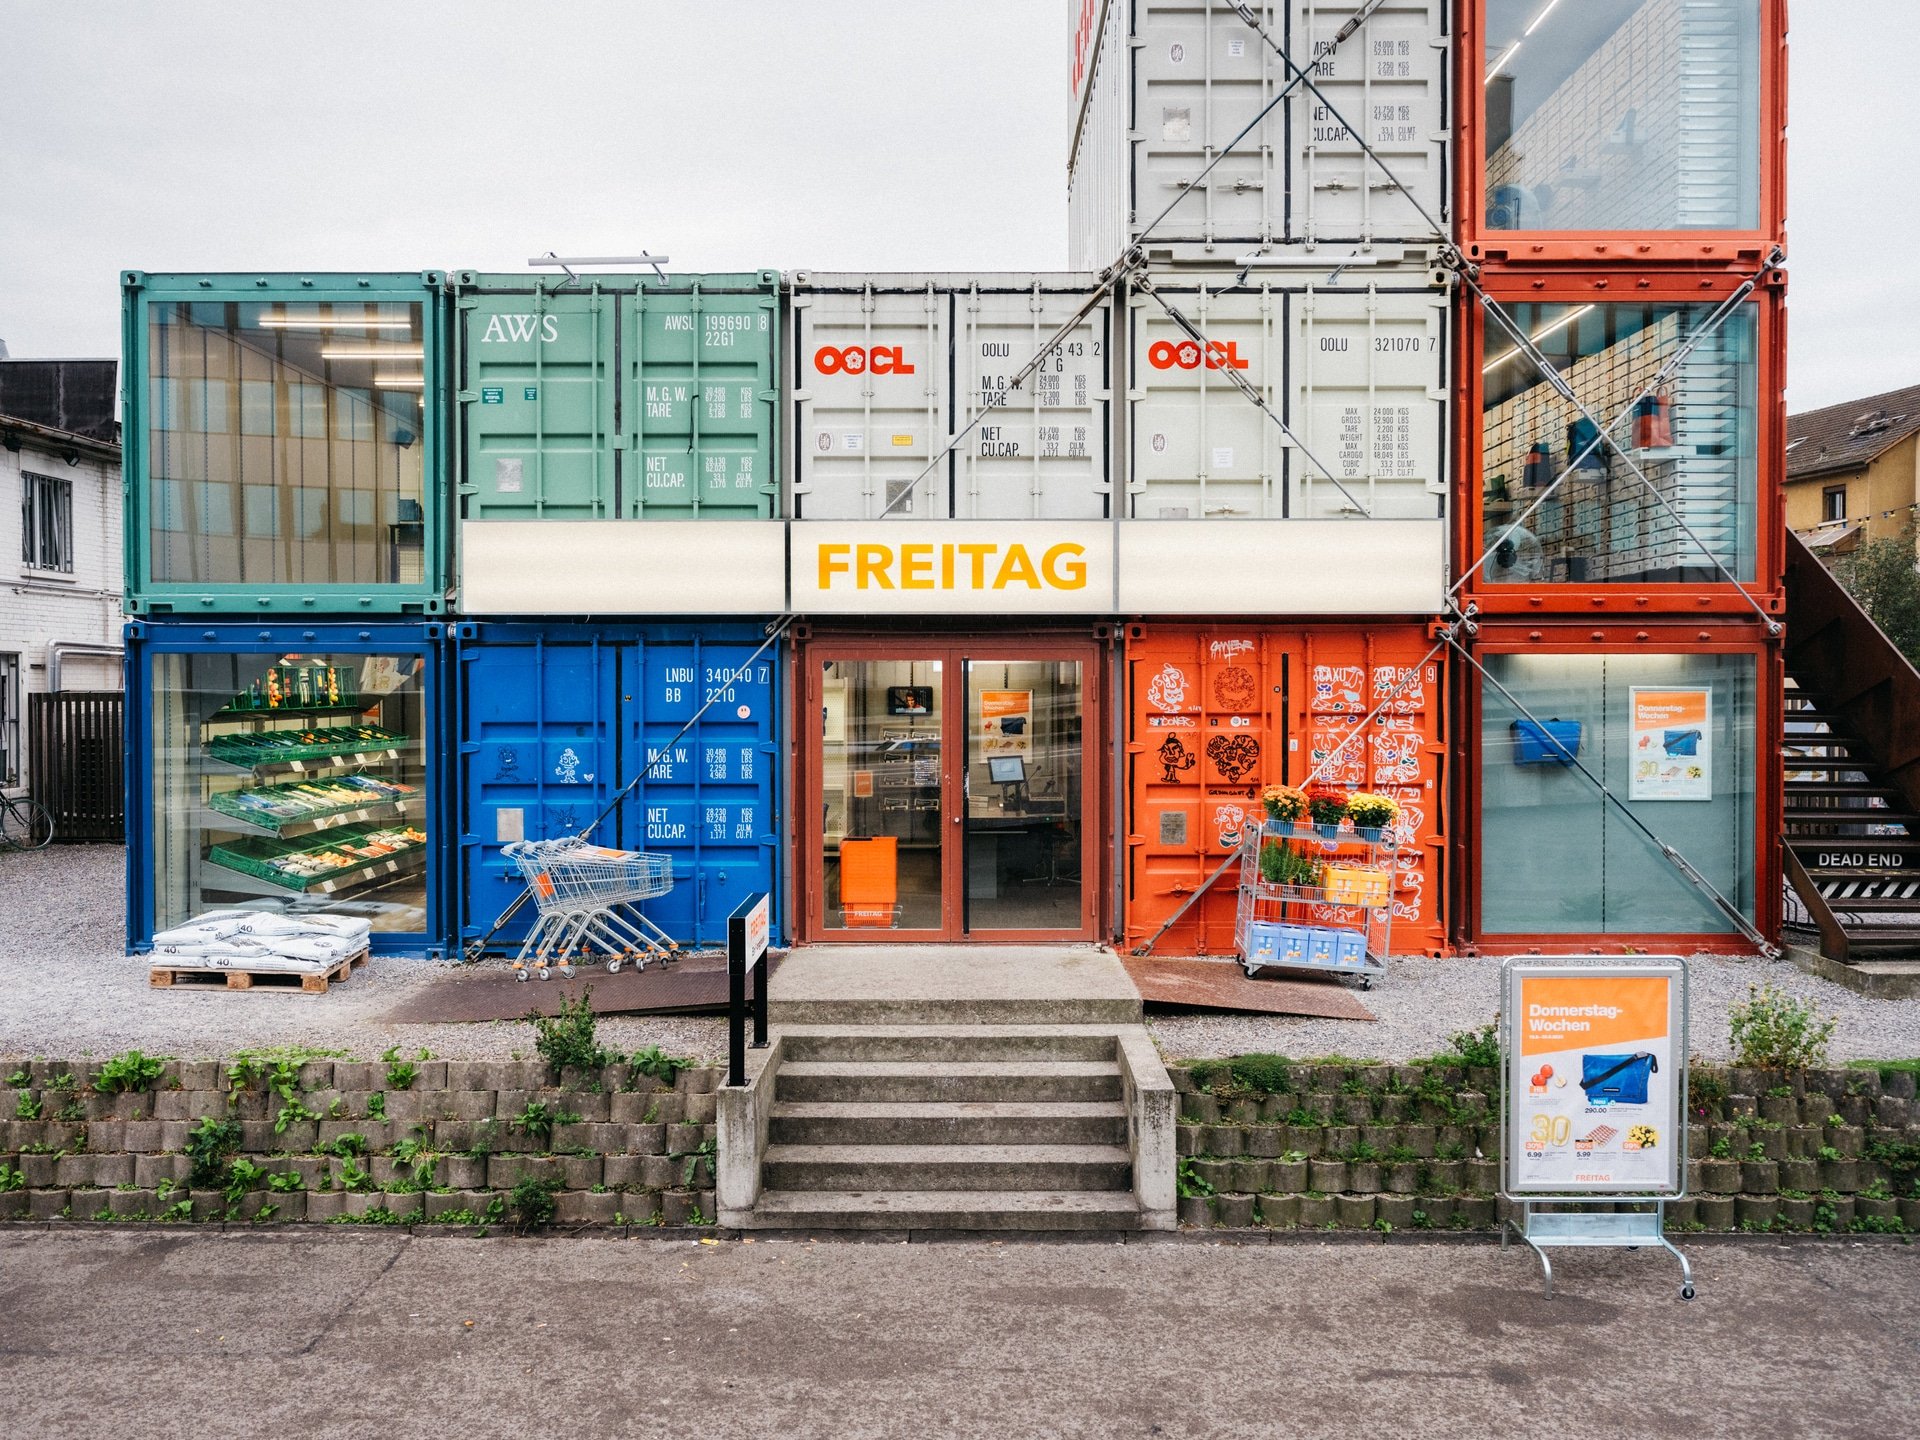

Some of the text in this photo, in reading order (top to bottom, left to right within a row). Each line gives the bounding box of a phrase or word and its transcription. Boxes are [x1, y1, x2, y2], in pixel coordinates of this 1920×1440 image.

[1314, 62, 1335, 76] ARE
[1314, 127, 1348, 141] U.CAP.
[481, 314, 558, 342] AWS
[705, 316, 750, 330] 199690
[760, 316, 767, 330] 8
[705, 332, 734, 346] 22G1
[1375, 337, 1419, 351] 321070
[1429, 338, 1436, 351] 7
[1068, 343, 1083, 356] 43
[1094, 342, 1100, 356] 2
[1148, 341, 1248, 369] OOCL
[814, 346, 914, 375] OOCL
[1056, 358, 1063, 372] G
[981, 392, 1006, 406] TARE
[646, 403, 672, 417] TARE
[981, 427, 1002, 440] NET
[981, 442, 1020, 457] CU.CAP.
[646, 457, 667, 471] NET
[646, 473, 685, 487] CU.CAP.
[818, 542, 1087, 590] FREITAG
[666, 668, 694, 682] LNBU
[760, 668, 766, 682] 7
[1428, 668, 1434, 682] 9
[706, 688, 735, 702] 2210
[647, 765, 672, 778] TARE
[648, 808, 668, 822] NET
[648, 824, 686, 838] CU.CAP.
[1819, 853, 1902, 866] DEAD END
[1529, 1004, 1623, 1019] Donnerstag-
[1529, 1019, 1590, 1031] Wochen
